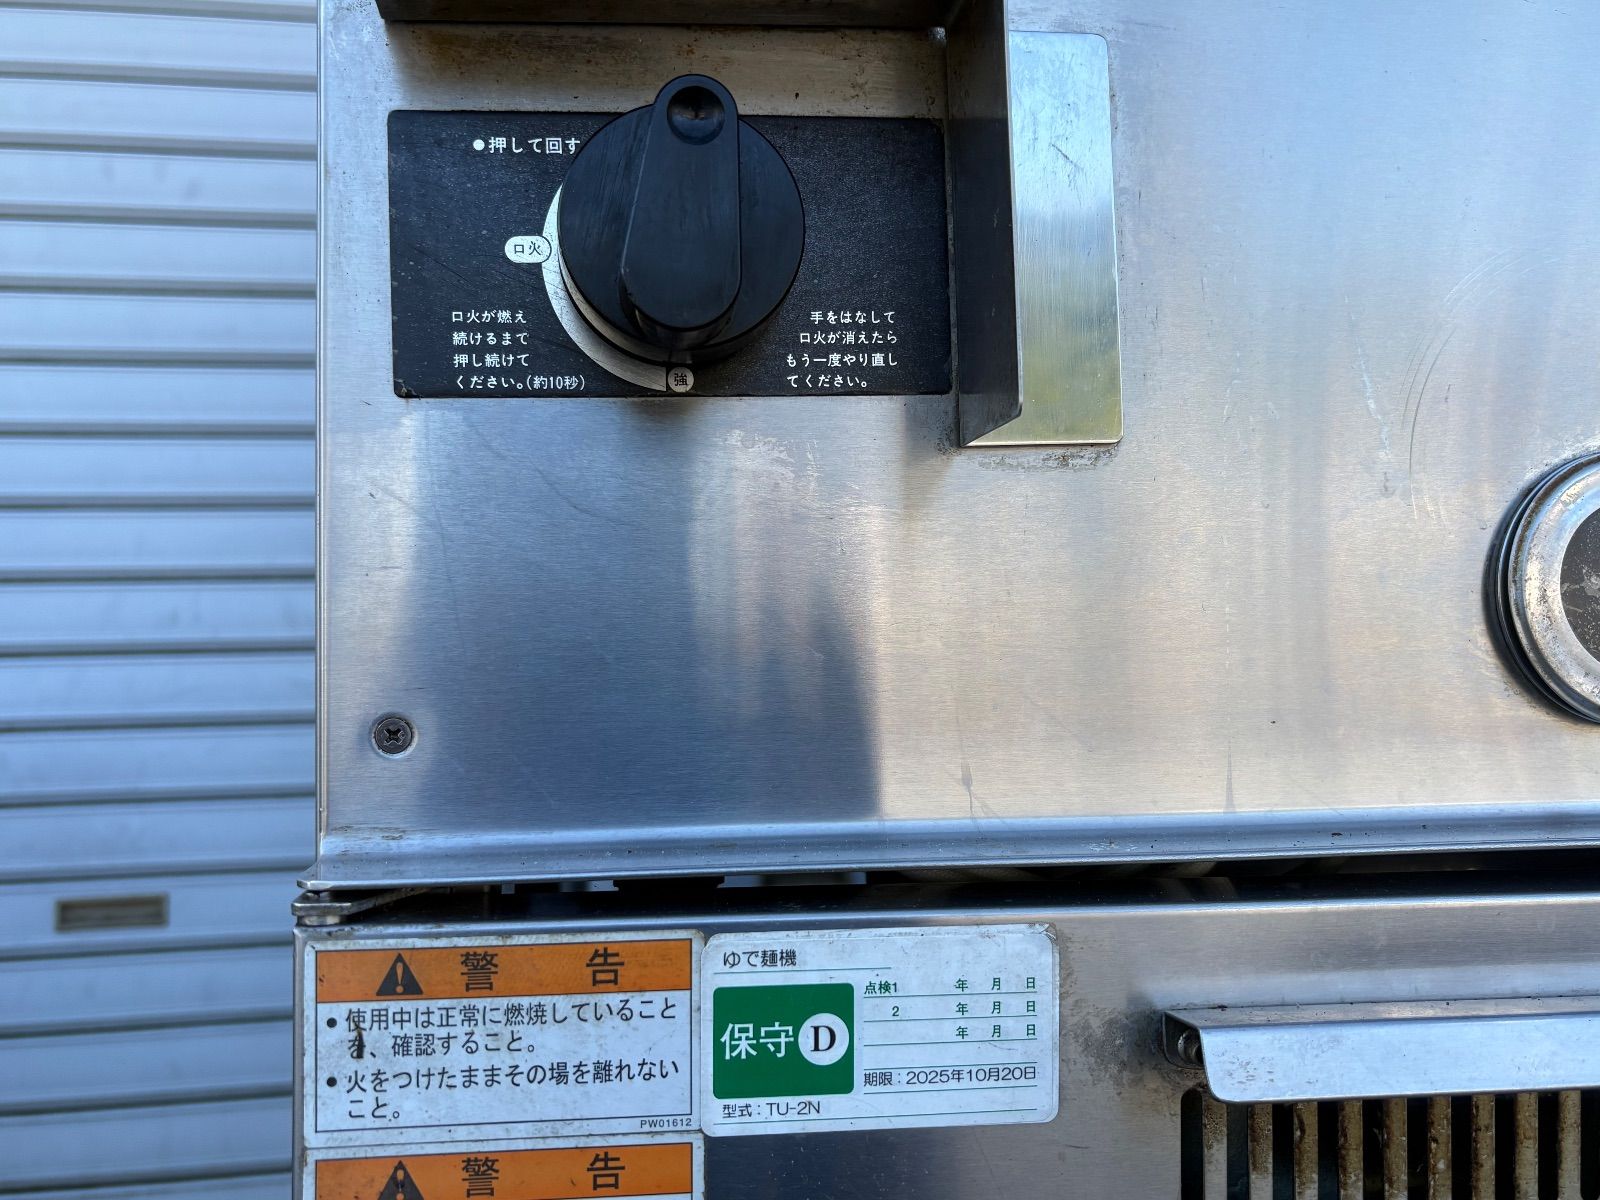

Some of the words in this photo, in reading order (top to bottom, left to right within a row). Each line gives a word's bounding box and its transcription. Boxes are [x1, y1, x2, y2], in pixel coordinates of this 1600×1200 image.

[488, 137, 581, 155] 押して回す
[513, 240, 542, 256] 口火
[451, 309, 527, 324] 口火が燃え
[810, 310, 895, 325] 手をはなして
[452, 331, 529, 346] 続けるまで
[800, 330, 898, 345] 口火が消えたら
[453, 353, 530, 368] 押し続けて
[786, 352, 898, 367] もう一度やり直し
[673, 372, 689, 387] 強
[787, 373, 868, 389] てください。
[345, 996, 677, 1033] 使用中は正常に燃焼していること
[891, 1005, 900, 1017] 2
[720, 1022, 794, 1060] 保守
[810, 1024, 836, 1052] D
[346, 1057, 679, 1094] 火をつけたままその場を離れない
[347, 1098, 401, 1120] こと。
[639, 1118, 692, 1129] PW01612
